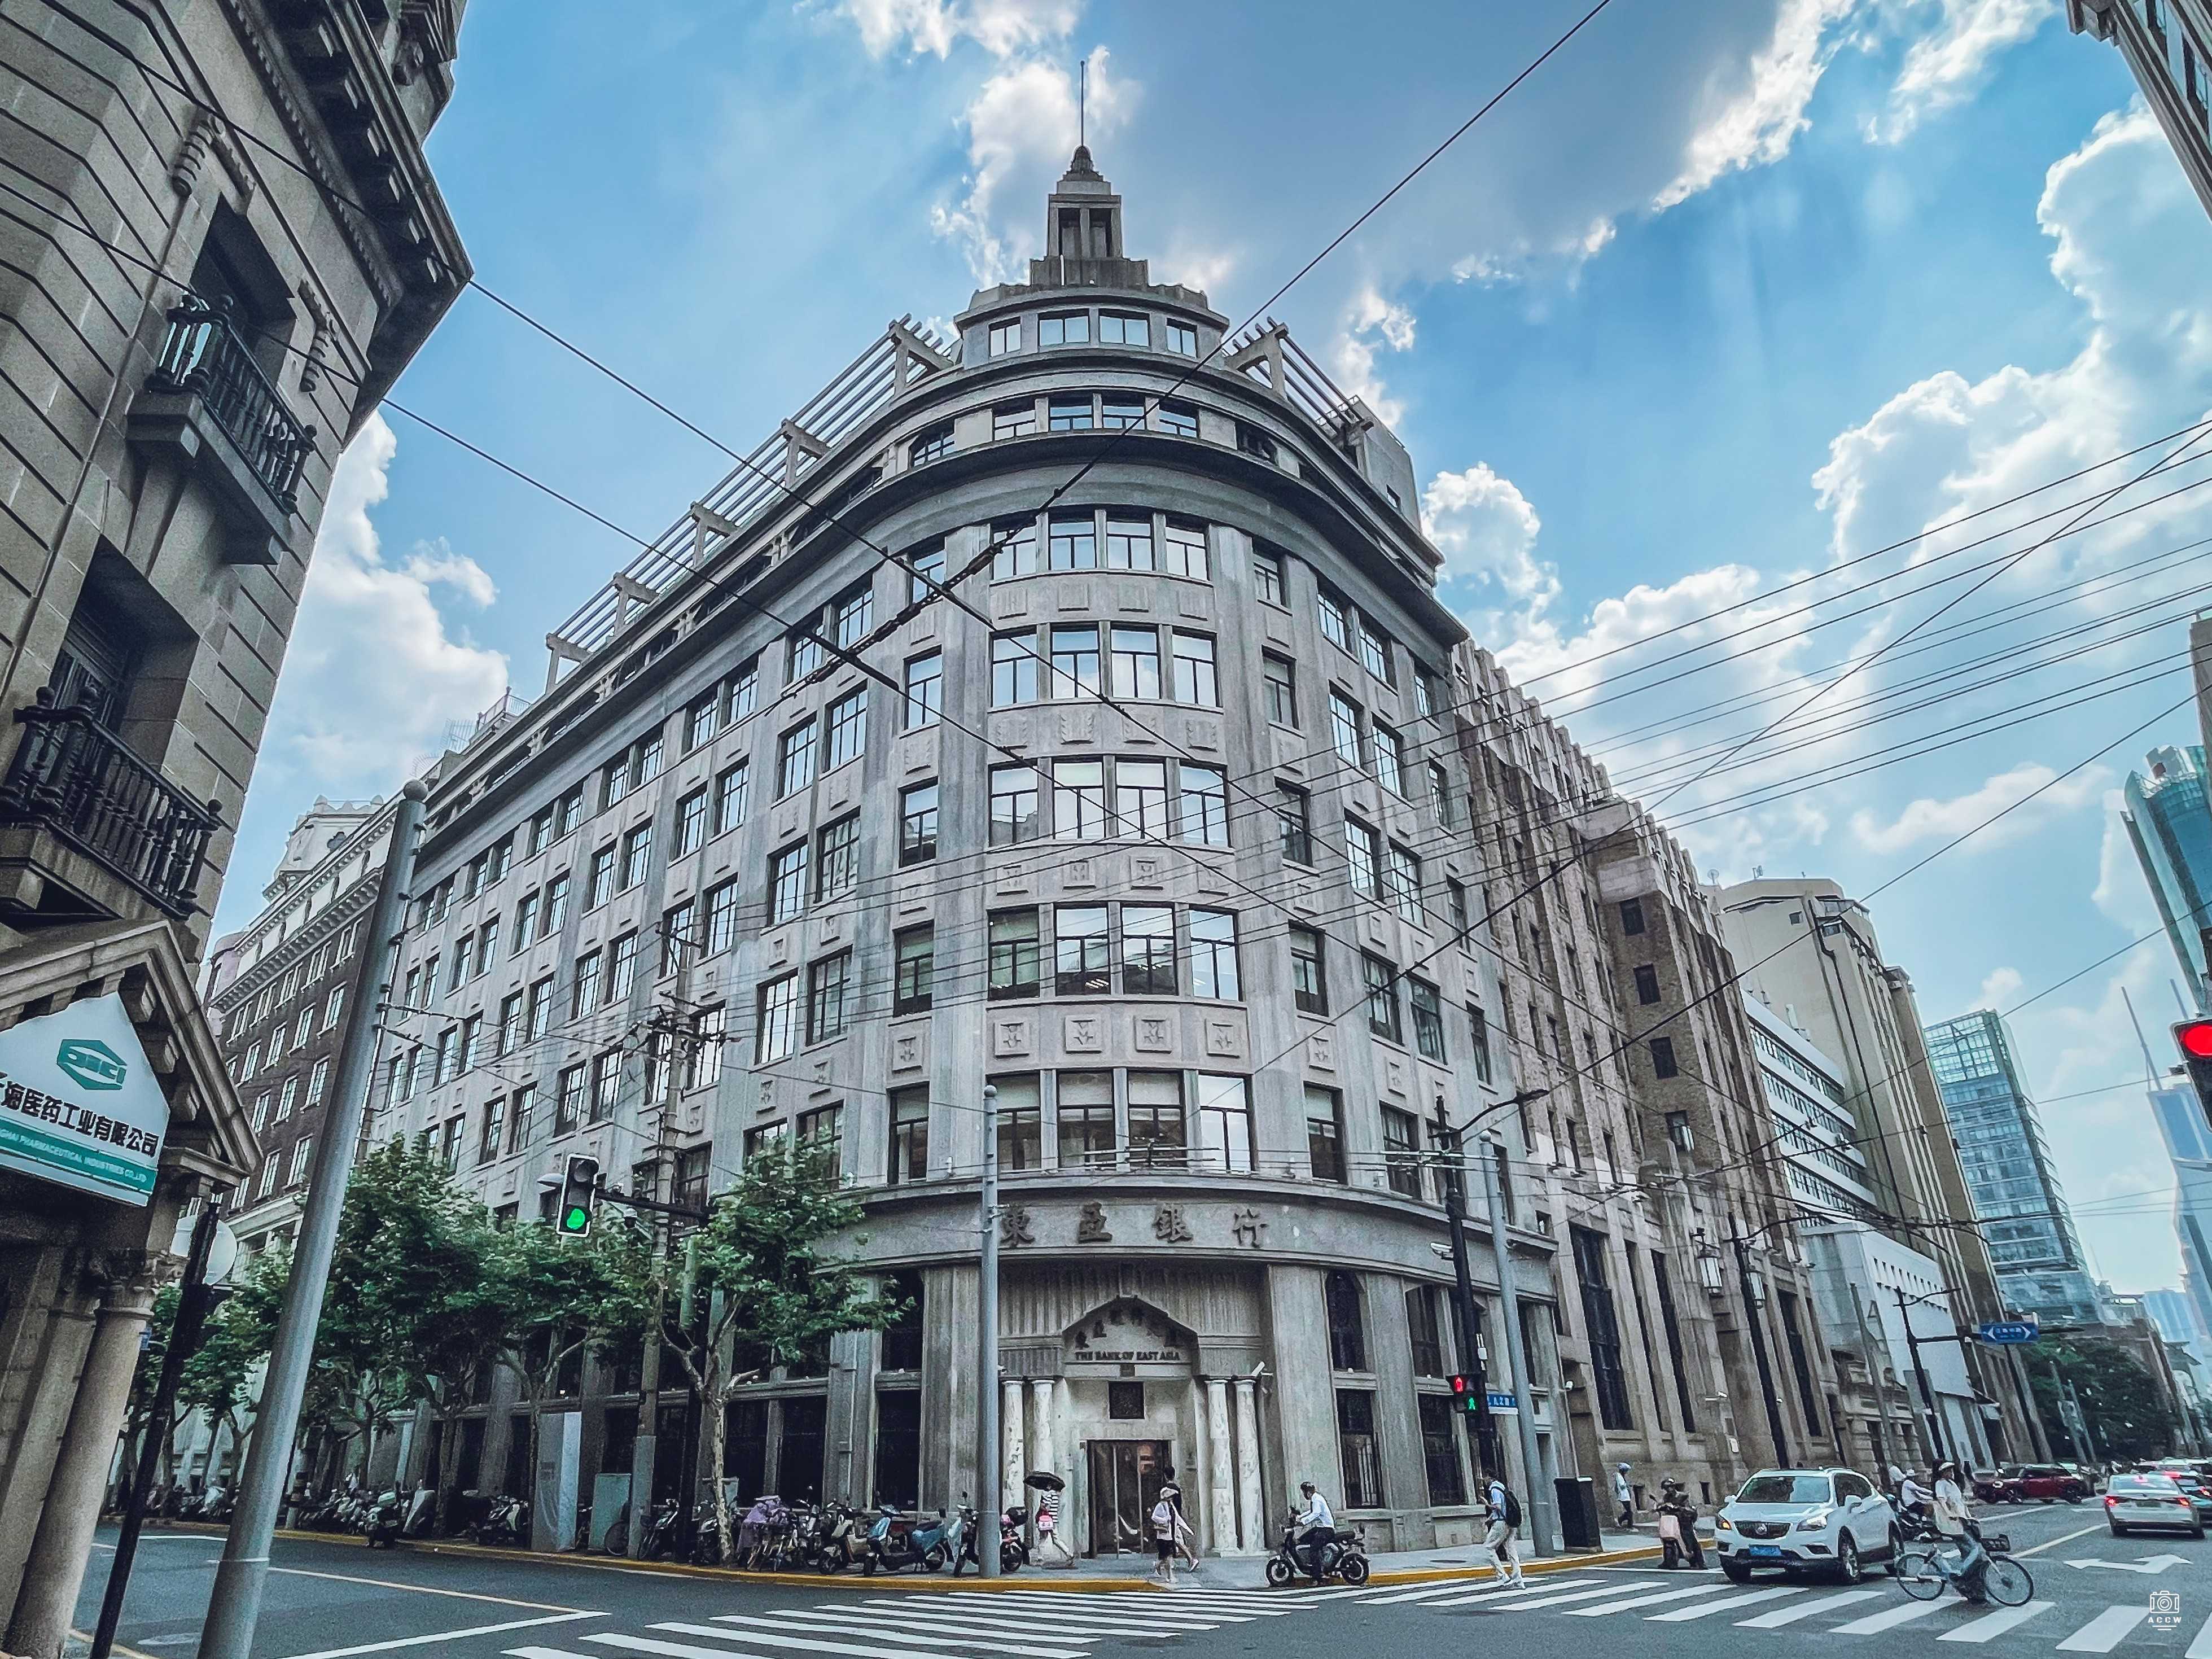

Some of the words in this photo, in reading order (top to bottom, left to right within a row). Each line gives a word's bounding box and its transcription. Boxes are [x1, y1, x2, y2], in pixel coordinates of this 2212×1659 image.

[1074, 1351, 1093, 1360] THE
[1095, 1351, 1121, 1360] BANK
[1136, 1351, 1159, 1360] EAST
[1159, 1351, 1180, 1360] ASIA
